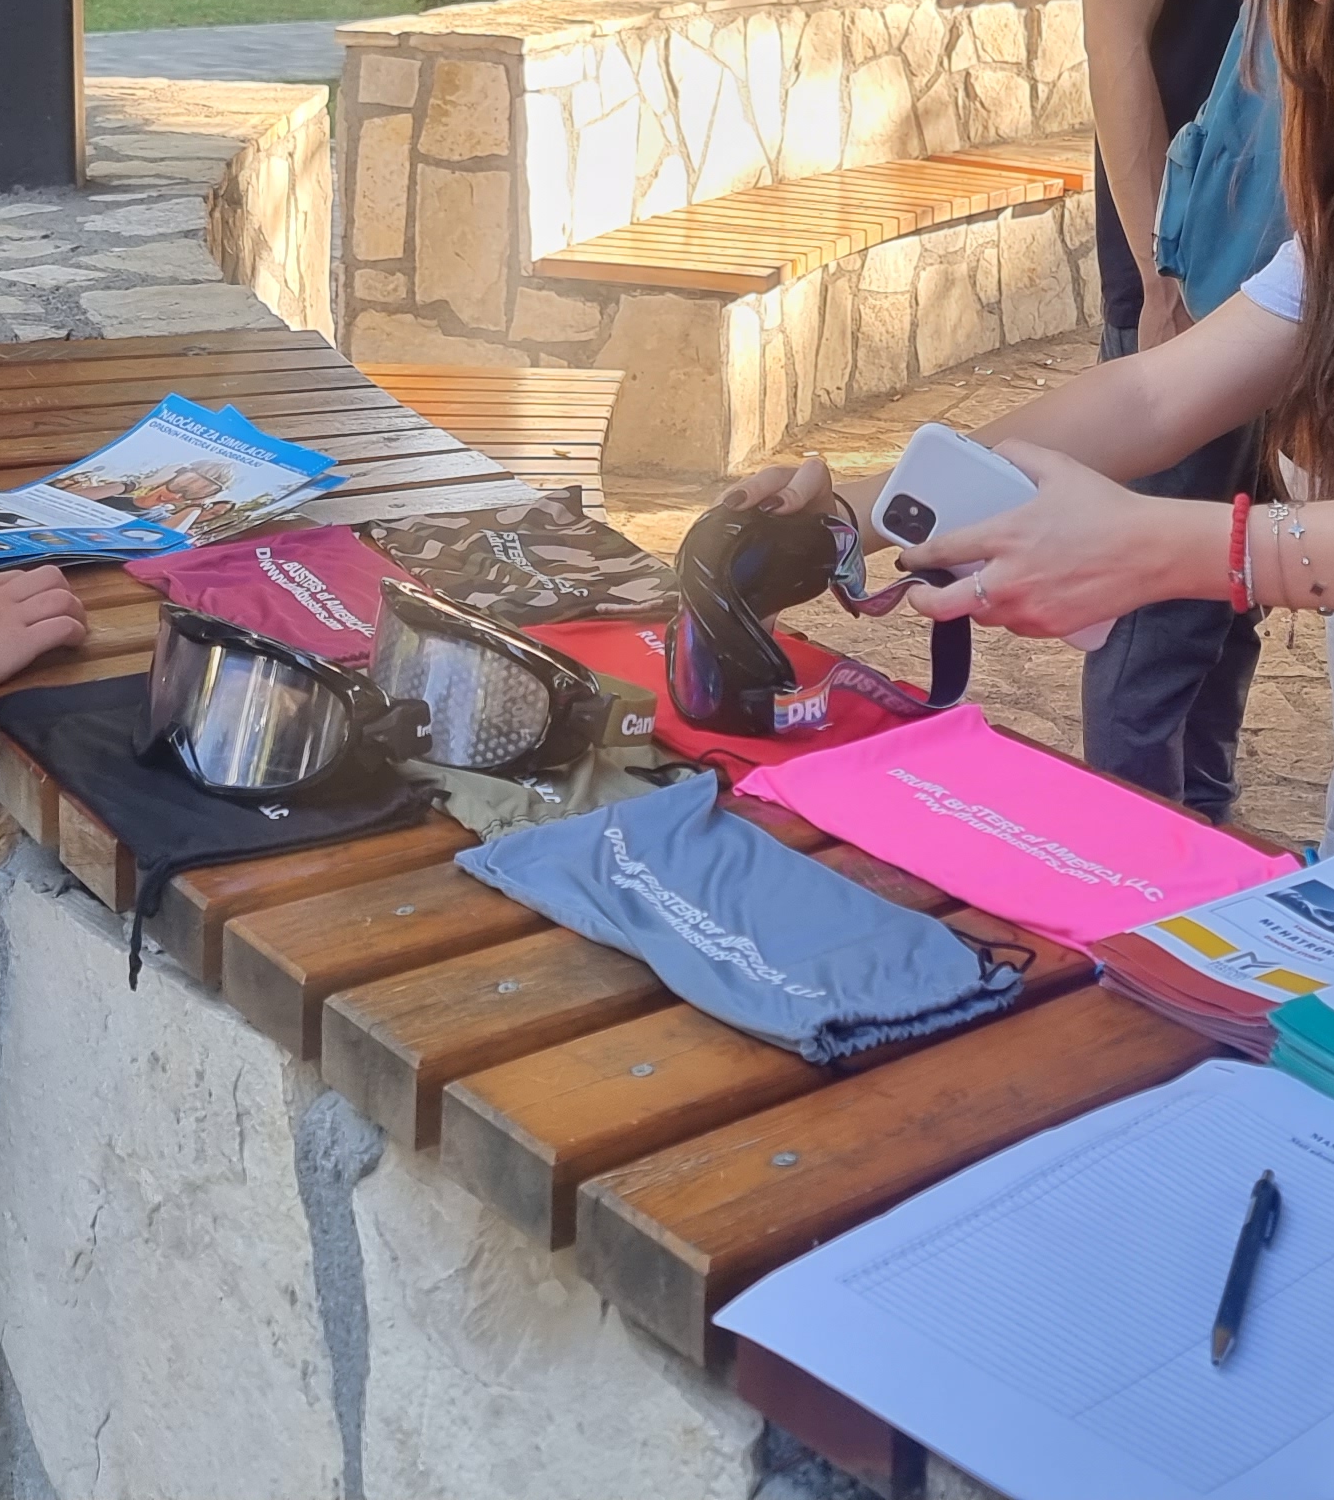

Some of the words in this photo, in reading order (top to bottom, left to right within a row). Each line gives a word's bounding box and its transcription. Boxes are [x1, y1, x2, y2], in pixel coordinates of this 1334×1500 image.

[158, 408, 208, 436] NAOČARE
[202, 429, 221, 441] ZA
[216, 436, 278, 461] SIMULACIJU
